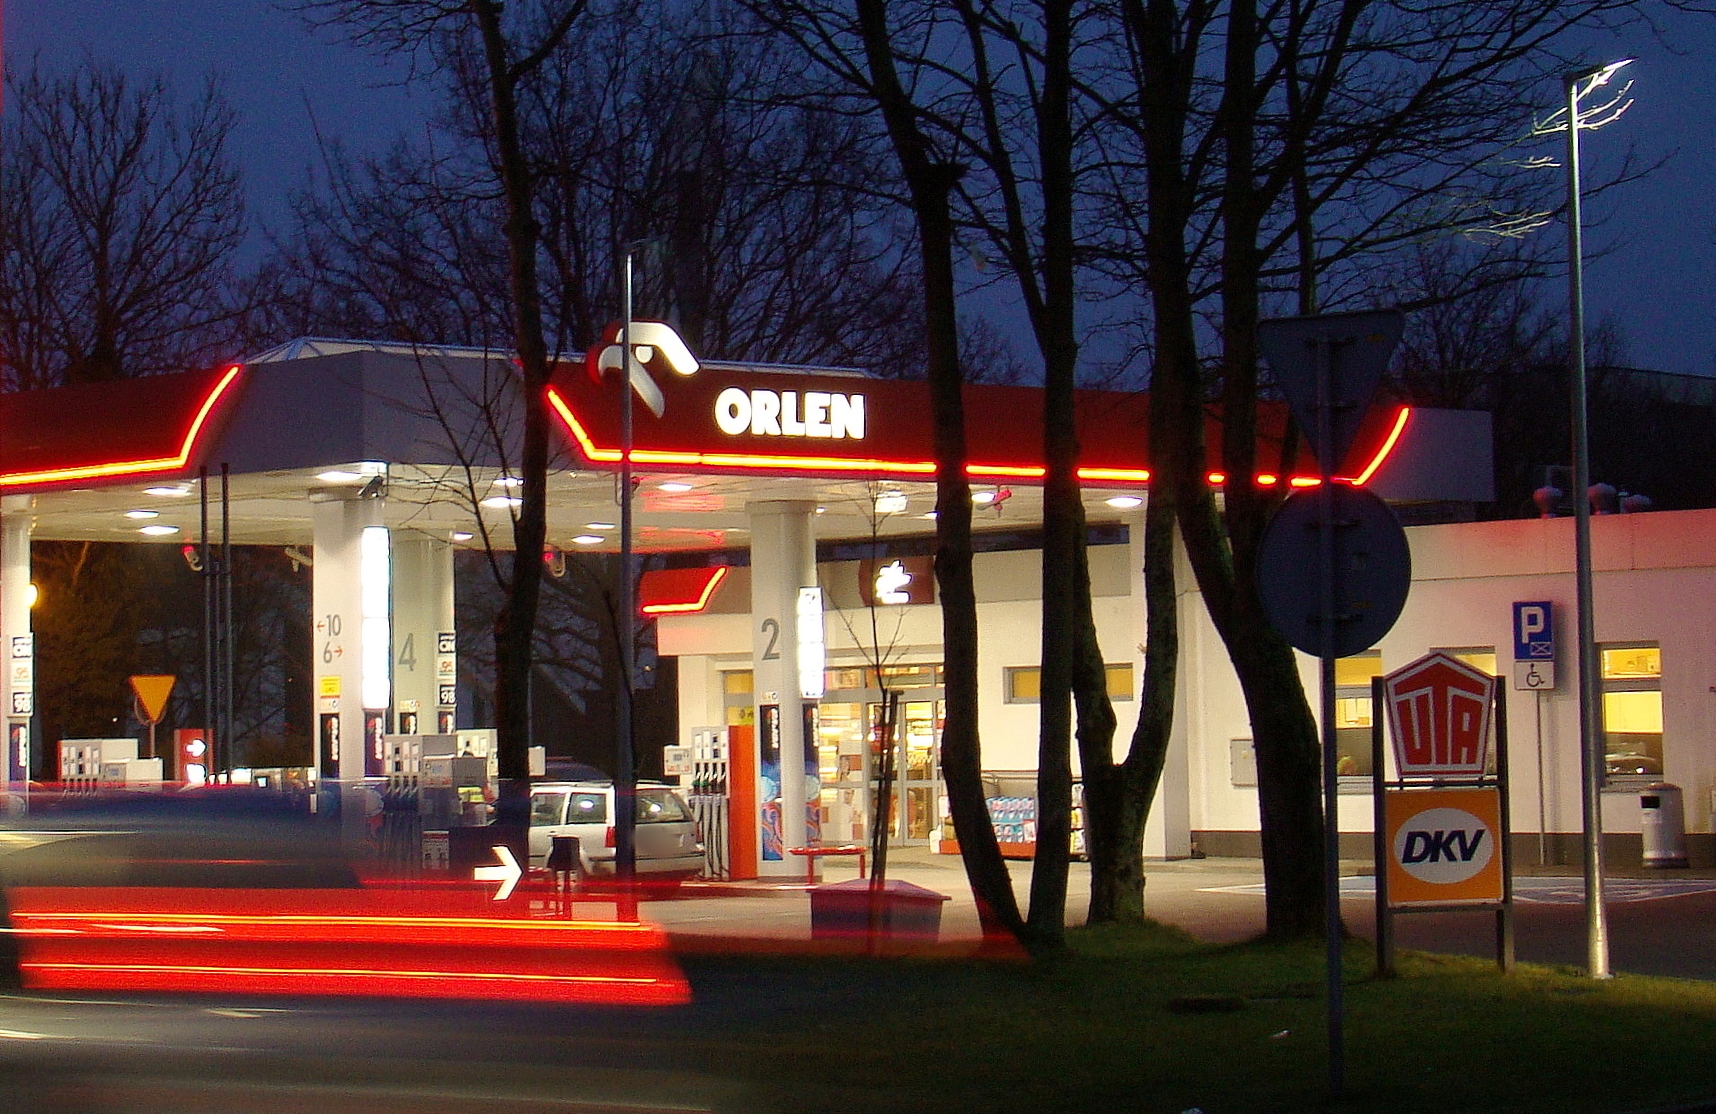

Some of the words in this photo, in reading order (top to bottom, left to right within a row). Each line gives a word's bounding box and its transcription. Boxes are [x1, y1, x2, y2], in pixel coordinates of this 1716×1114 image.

[714, 387, 865, 440] ORLEN
[326, 614, 342, 637] 10
[761, 618, 780, 661] 2
[1521, 606, 1544, 644] P
[323, 641, 333, 664] 6
[399, 633, 417, 671] 4
[441, 691, 456, 704] 98
[1394, 661, 1486, 766] UTA
[1401, 828, 1486, 864] DKV
